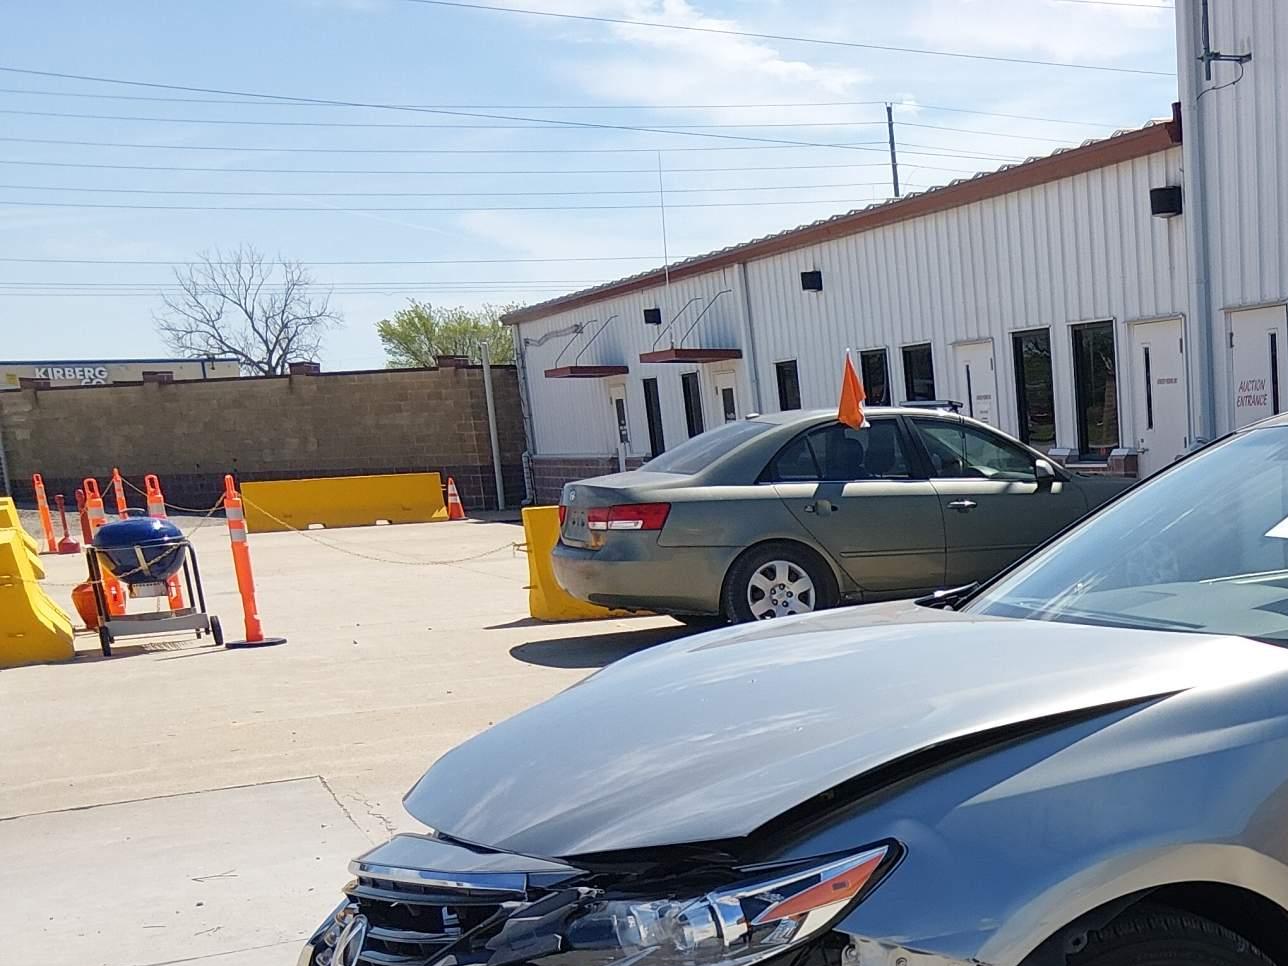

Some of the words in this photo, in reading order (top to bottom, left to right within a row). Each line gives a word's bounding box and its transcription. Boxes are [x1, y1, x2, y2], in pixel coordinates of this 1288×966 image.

[35, 367, 108, 380] KIRBERG
[1239, 379, 1266, 392] AUCTION
[1237, 394, 1268, 407] ENTRANCE
